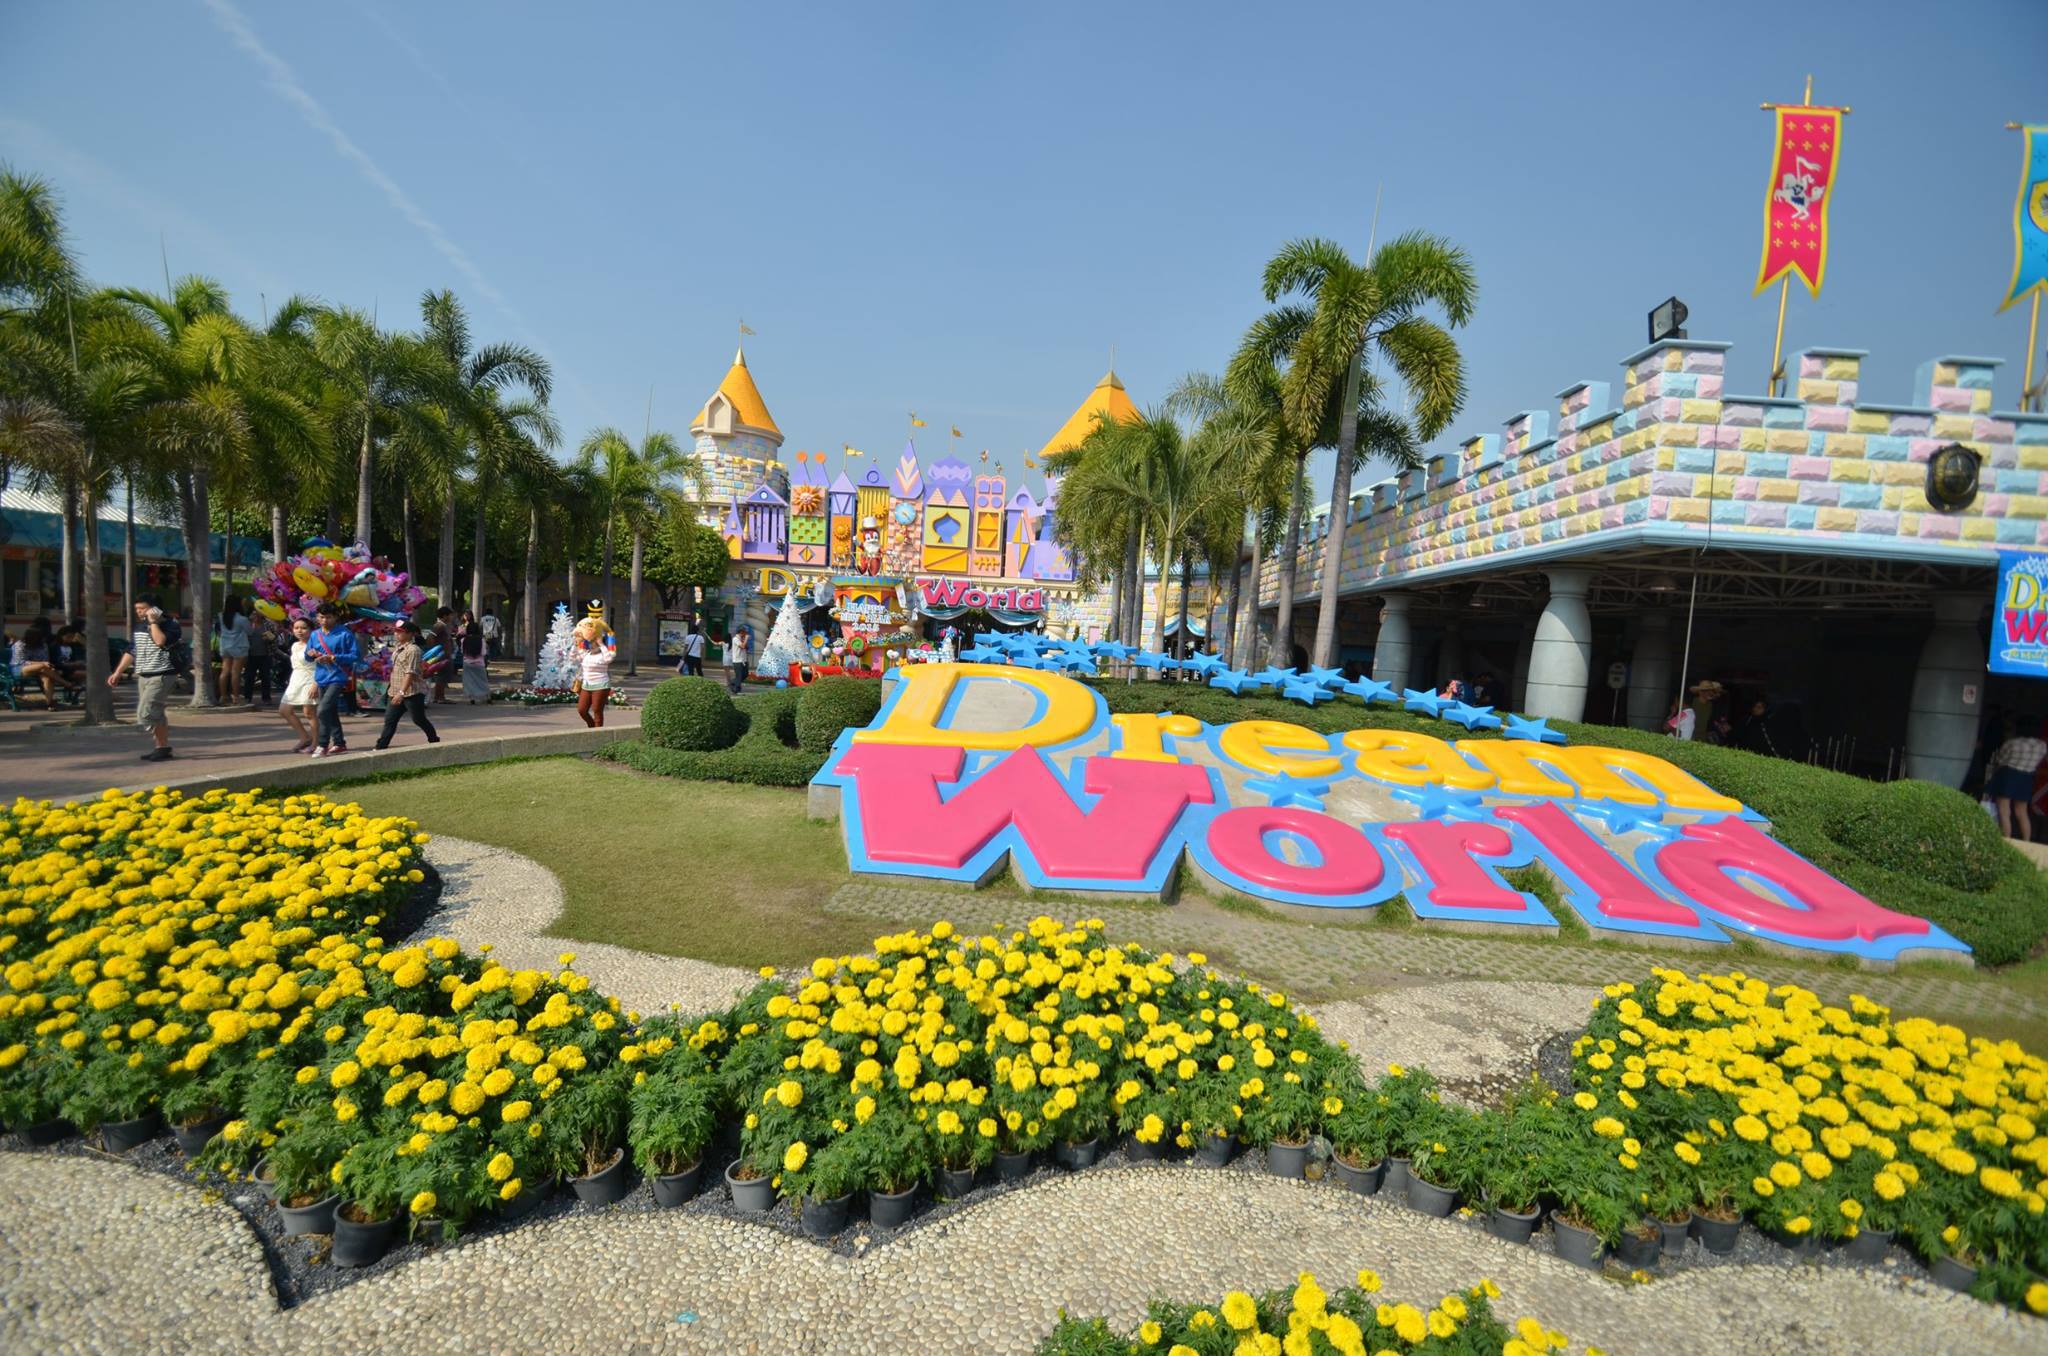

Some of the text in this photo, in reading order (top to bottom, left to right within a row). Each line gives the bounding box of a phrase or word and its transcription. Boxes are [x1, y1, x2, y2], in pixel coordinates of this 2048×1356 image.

[914, 575, 1046, 611] World
[853, 662, 1744, 812] Dream
[832, 743, 1930, 942] World
